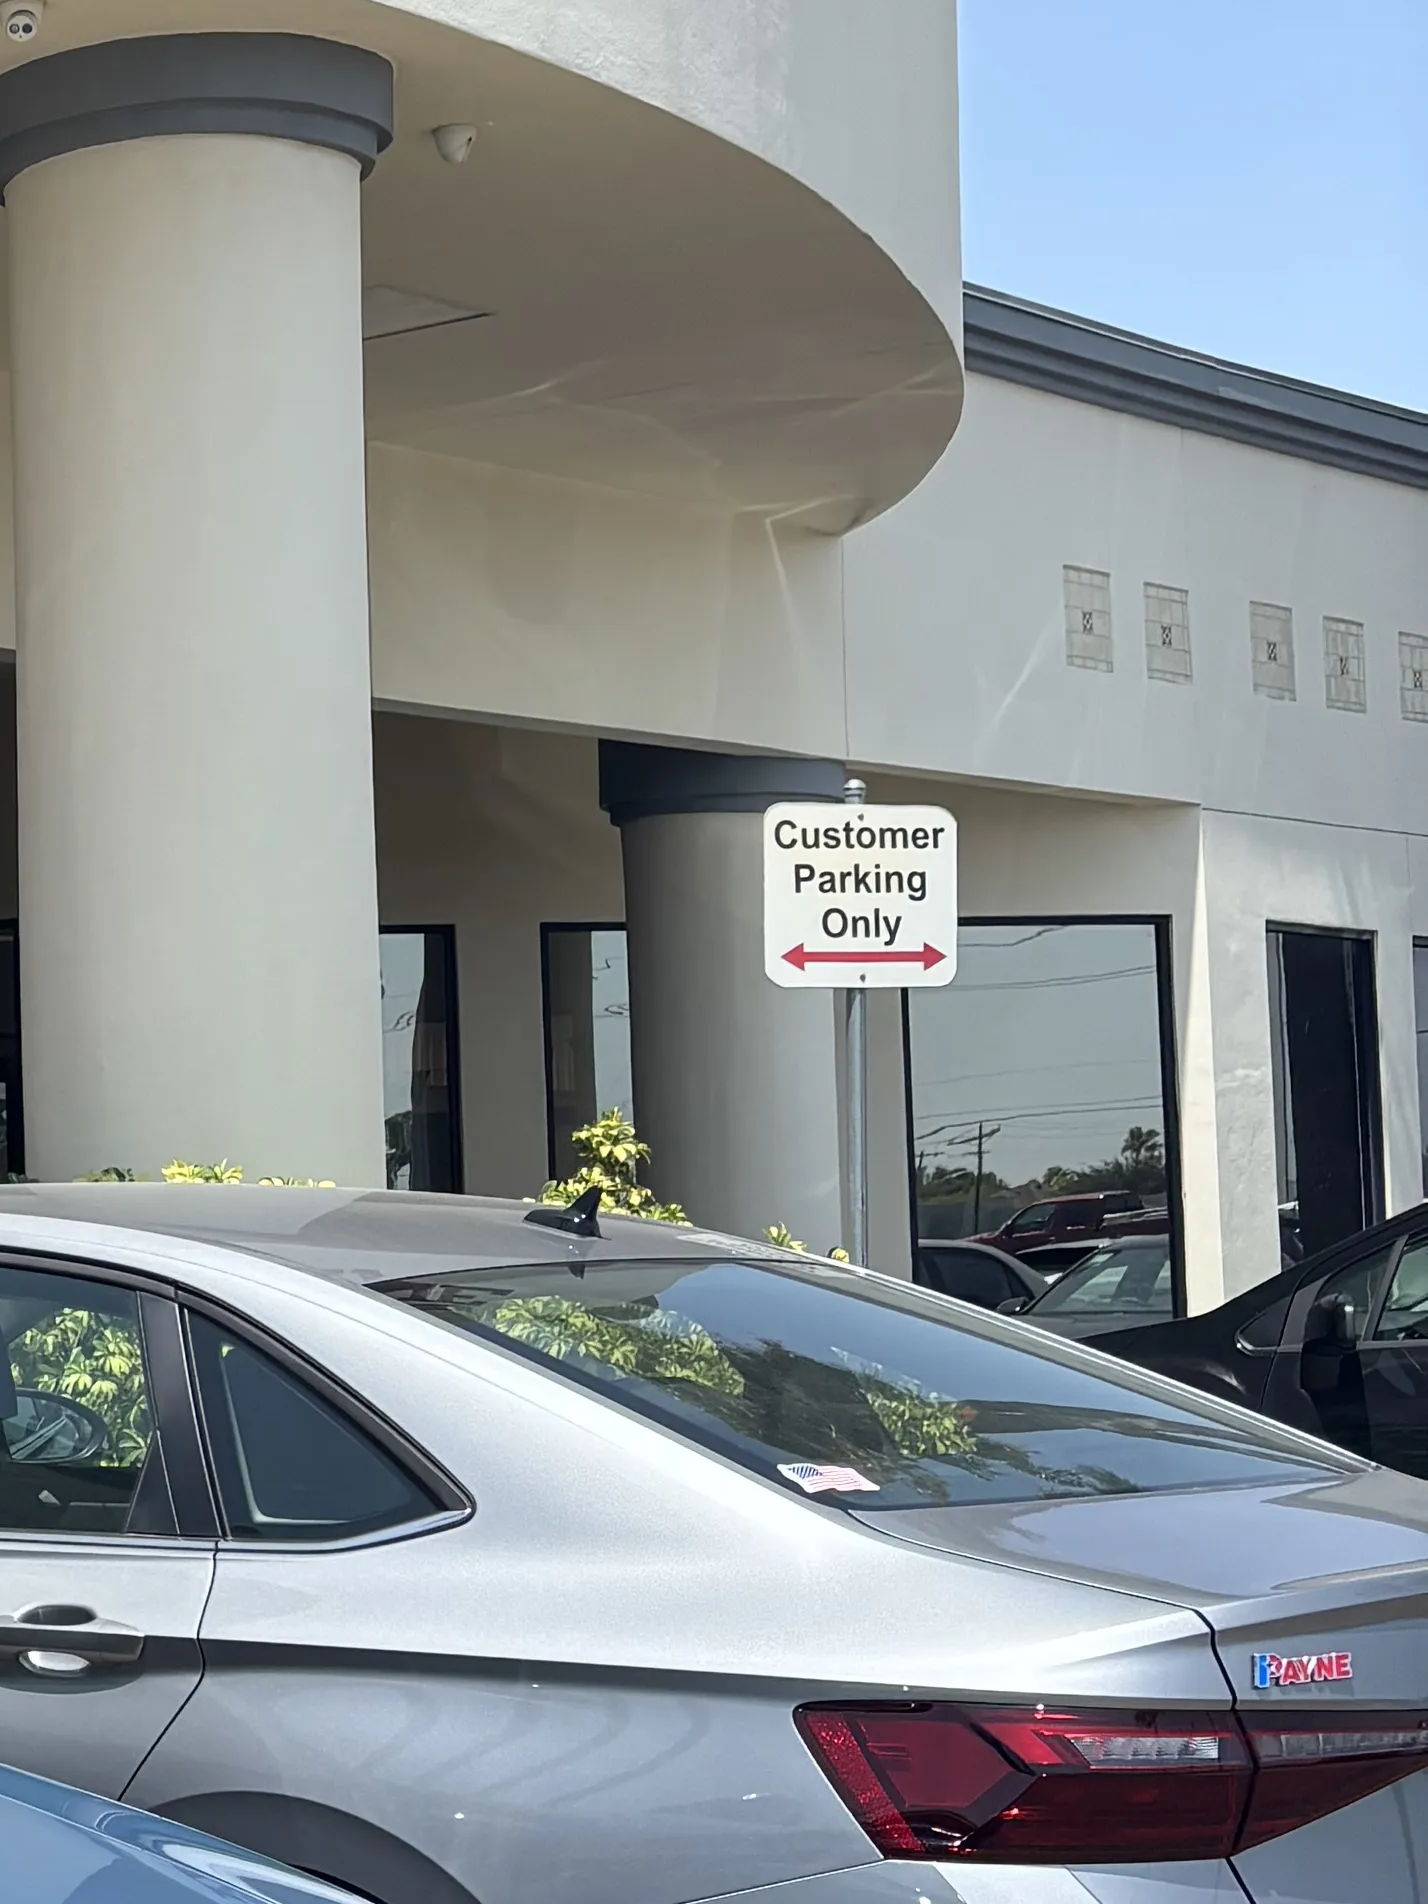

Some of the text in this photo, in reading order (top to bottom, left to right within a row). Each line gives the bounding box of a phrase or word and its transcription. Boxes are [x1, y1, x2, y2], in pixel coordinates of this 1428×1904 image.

[774, 820, 945, 849] Customer
[794, 863, 927, 901] Parking
[822, 907, 902, 946] Only
[1253, 1651, 1353, 1689] PAYNE
